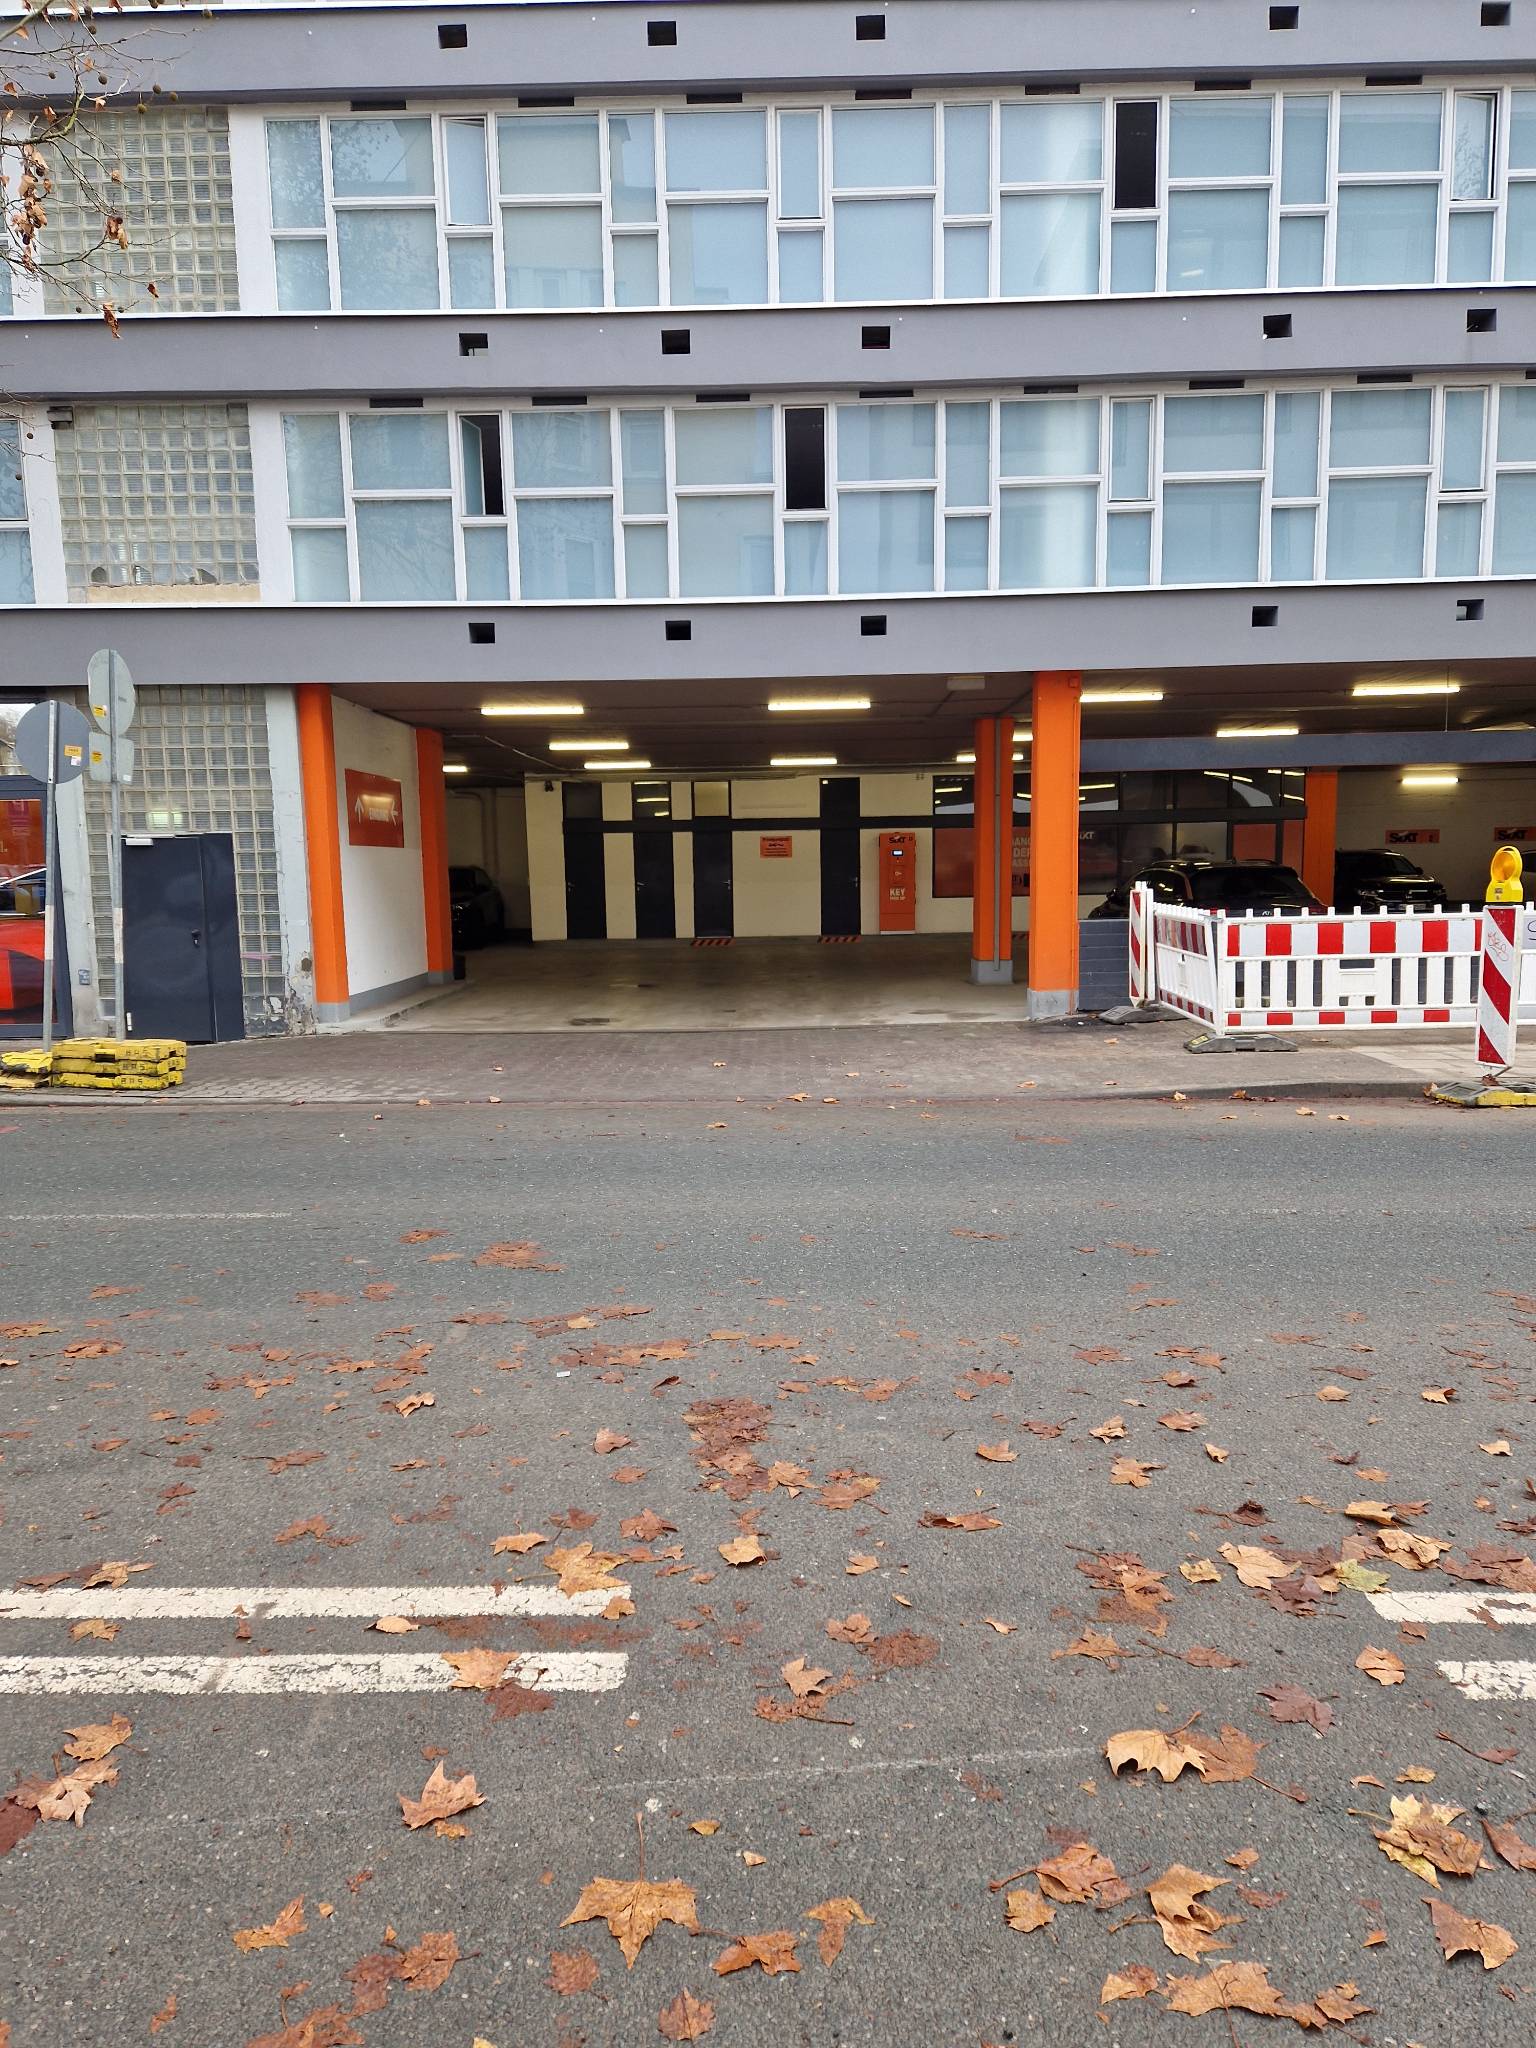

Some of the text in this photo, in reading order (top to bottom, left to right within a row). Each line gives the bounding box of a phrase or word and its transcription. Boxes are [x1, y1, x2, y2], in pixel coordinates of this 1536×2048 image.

[889, 836, 906, 844] SIXT
[1079, 831, 1095, 840] IXT
[1389, 831, 1418, 843] SIXT
[1497, 829, 1528, 841] SIXT
[889, 887, 906, 897] KEY
